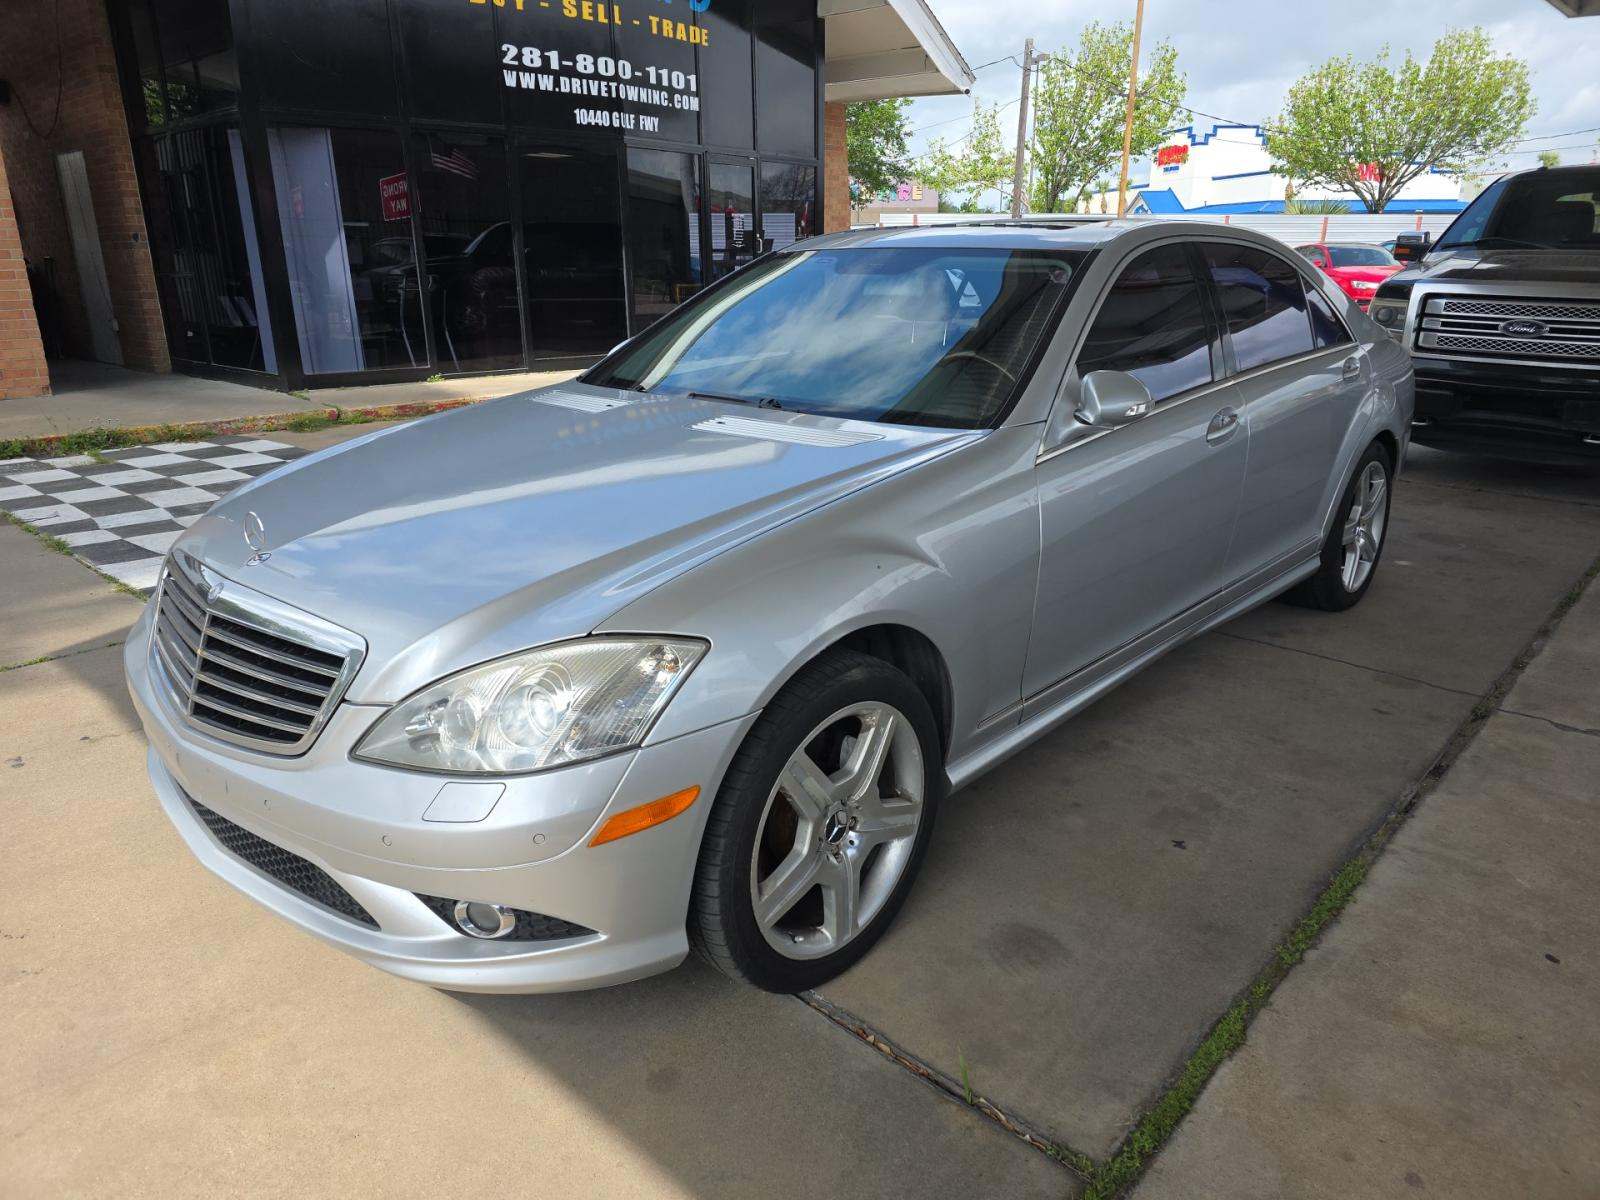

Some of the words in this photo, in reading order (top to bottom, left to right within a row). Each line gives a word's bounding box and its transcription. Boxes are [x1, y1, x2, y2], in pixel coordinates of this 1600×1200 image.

[562, 0, 622, 26] SELL
[649, 15, 709, 46] TRADE
[501, 43, 697, 92] 281-800-1101
[502, 69, 700, 112] WWW.DRIVETOWNINC.COM
[574, 108, 610, 127] 10440
[612, 110, 637, 130] GULF
[639, 114, 660, 133] FWY
